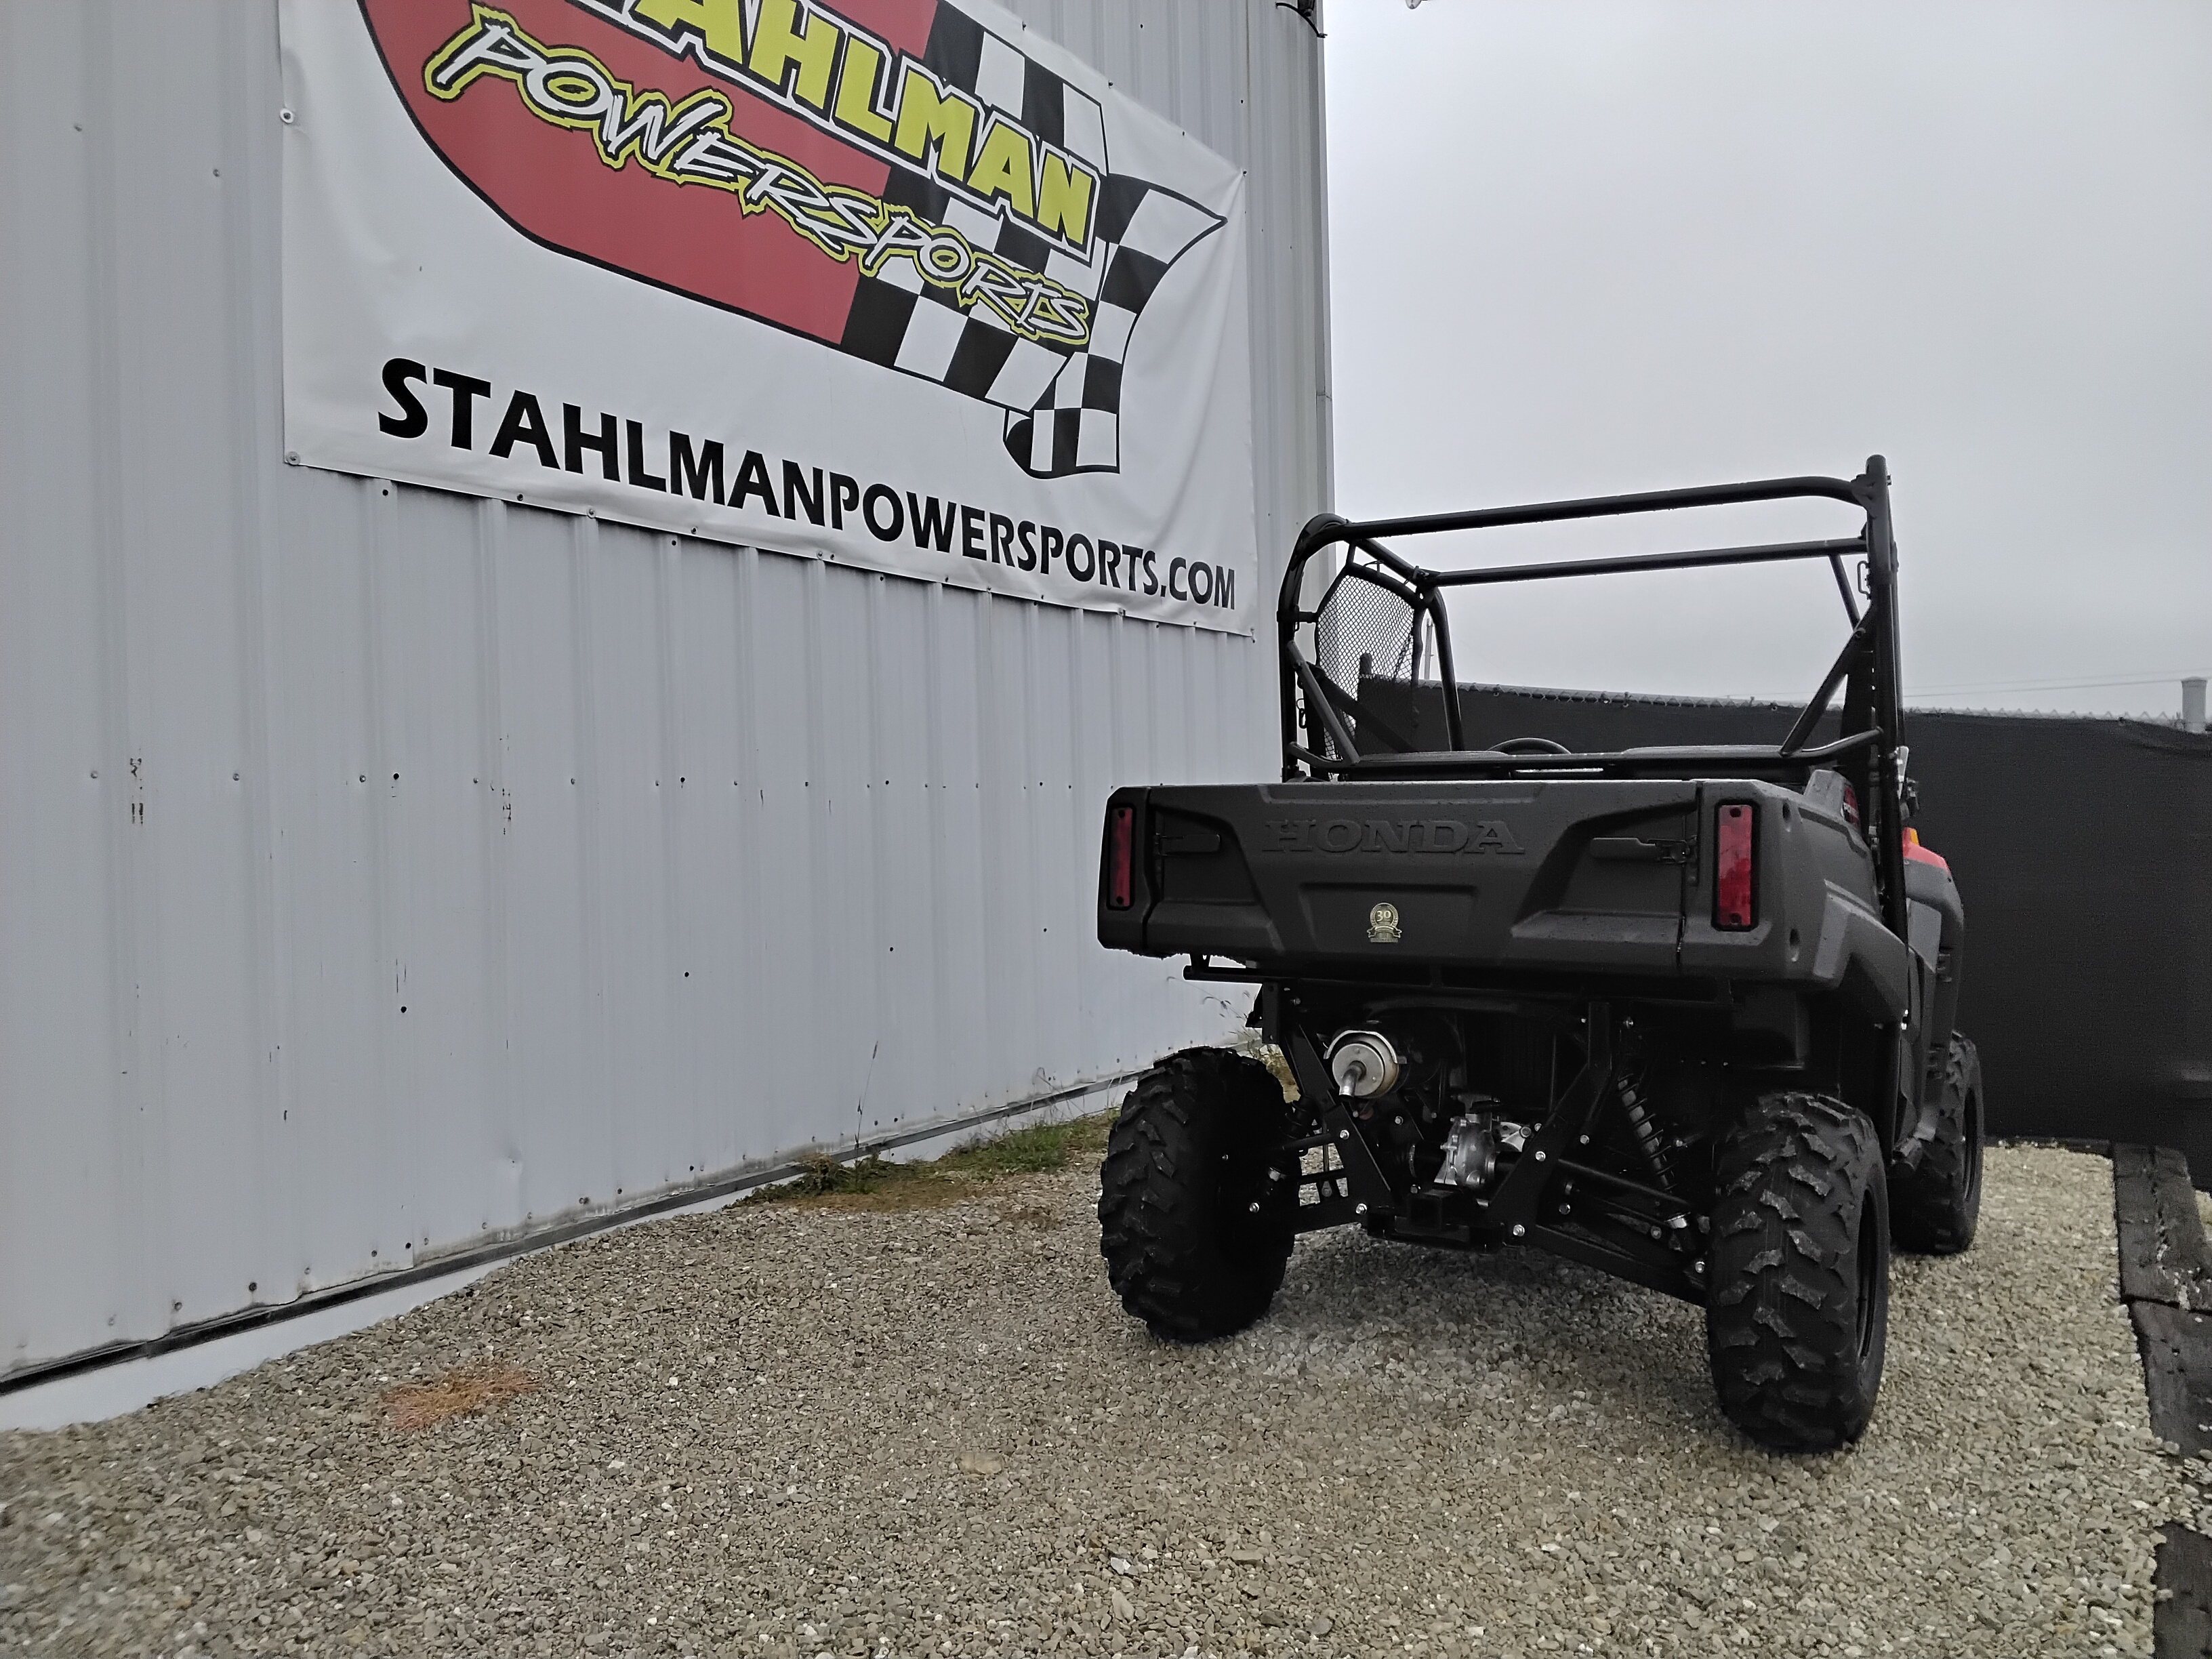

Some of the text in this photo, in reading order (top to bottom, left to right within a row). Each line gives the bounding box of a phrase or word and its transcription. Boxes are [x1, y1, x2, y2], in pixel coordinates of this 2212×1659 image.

[432, 19, 1087, 339] POWERSPORTS
[377, 357, 1235, 610] STAHLMANPOWERSPORTS.COM
[1262, 819, 1525, 855] HONDA
[1376, 910, 1391, 922] 30
